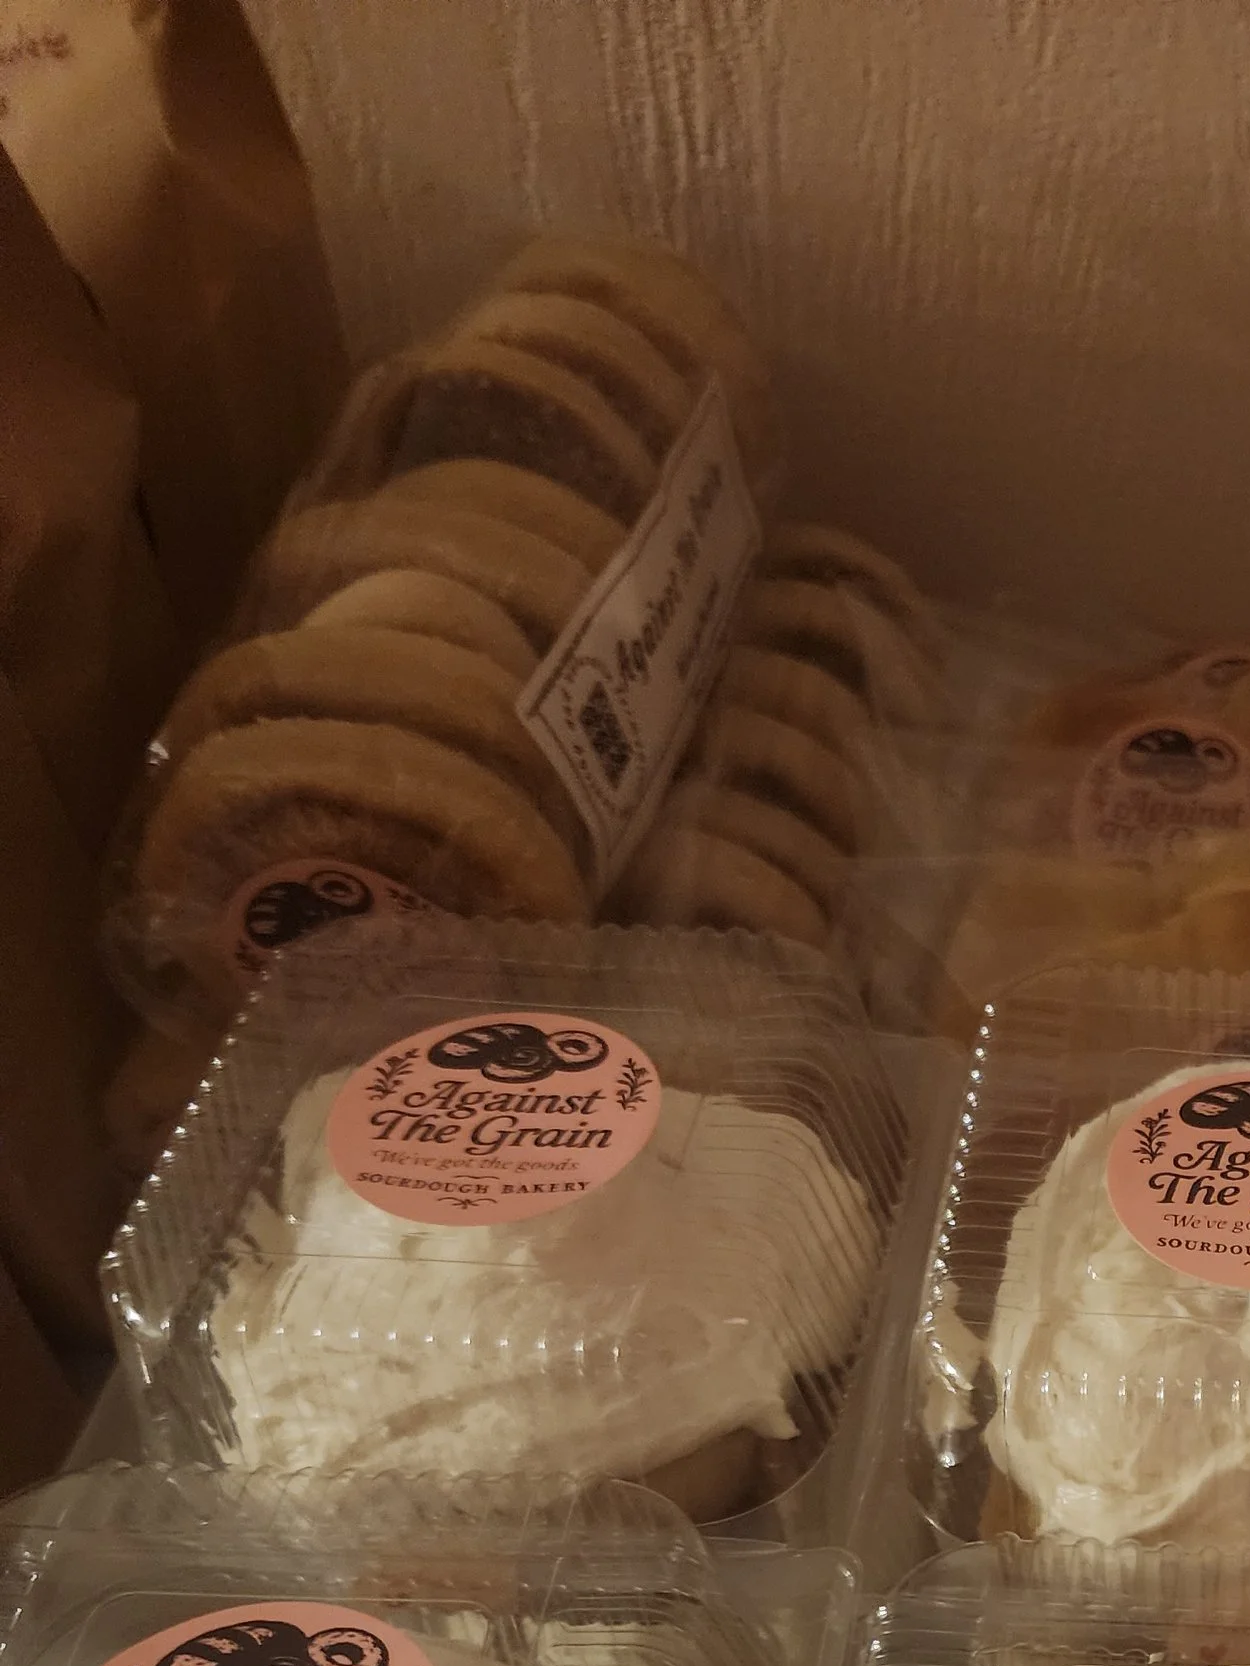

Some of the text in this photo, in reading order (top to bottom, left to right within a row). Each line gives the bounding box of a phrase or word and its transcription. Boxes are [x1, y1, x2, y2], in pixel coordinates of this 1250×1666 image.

[404, 1081, 606, 1119] Against
[371, 1109, 612, 1156] The Grain
[437, 1155, 477, 1170] got
[480, 1153, 511, 1170] the
[515, 1157, 579, 1172] goods
[357, 1172, 591, 1194] SOURDOUGH BAKERY
[1148, 1172, 1240, 1206] The
[1164, 1213, 1228, 1230] We've
